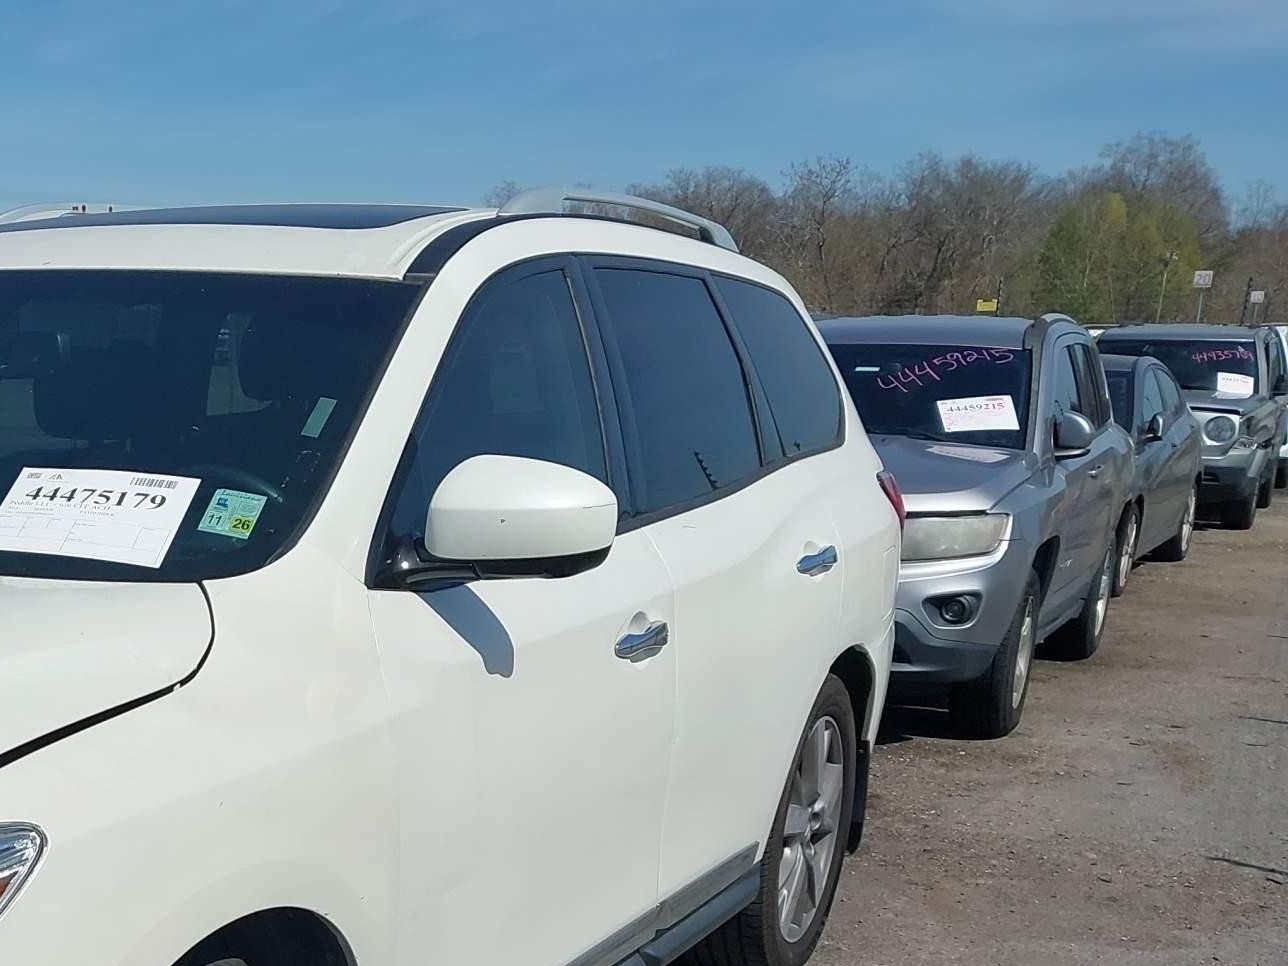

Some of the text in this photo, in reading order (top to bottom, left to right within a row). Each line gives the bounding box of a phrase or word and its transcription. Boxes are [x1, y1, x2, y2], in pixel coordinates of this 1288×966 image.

[876, 348, 1014, 392] 44459215
[947, 402, 1005, 413] 44459215
[25, 486, 167, 510] 44475179
[208, 514, 222, 526] 11
[232, 518, 251, 530] 26
